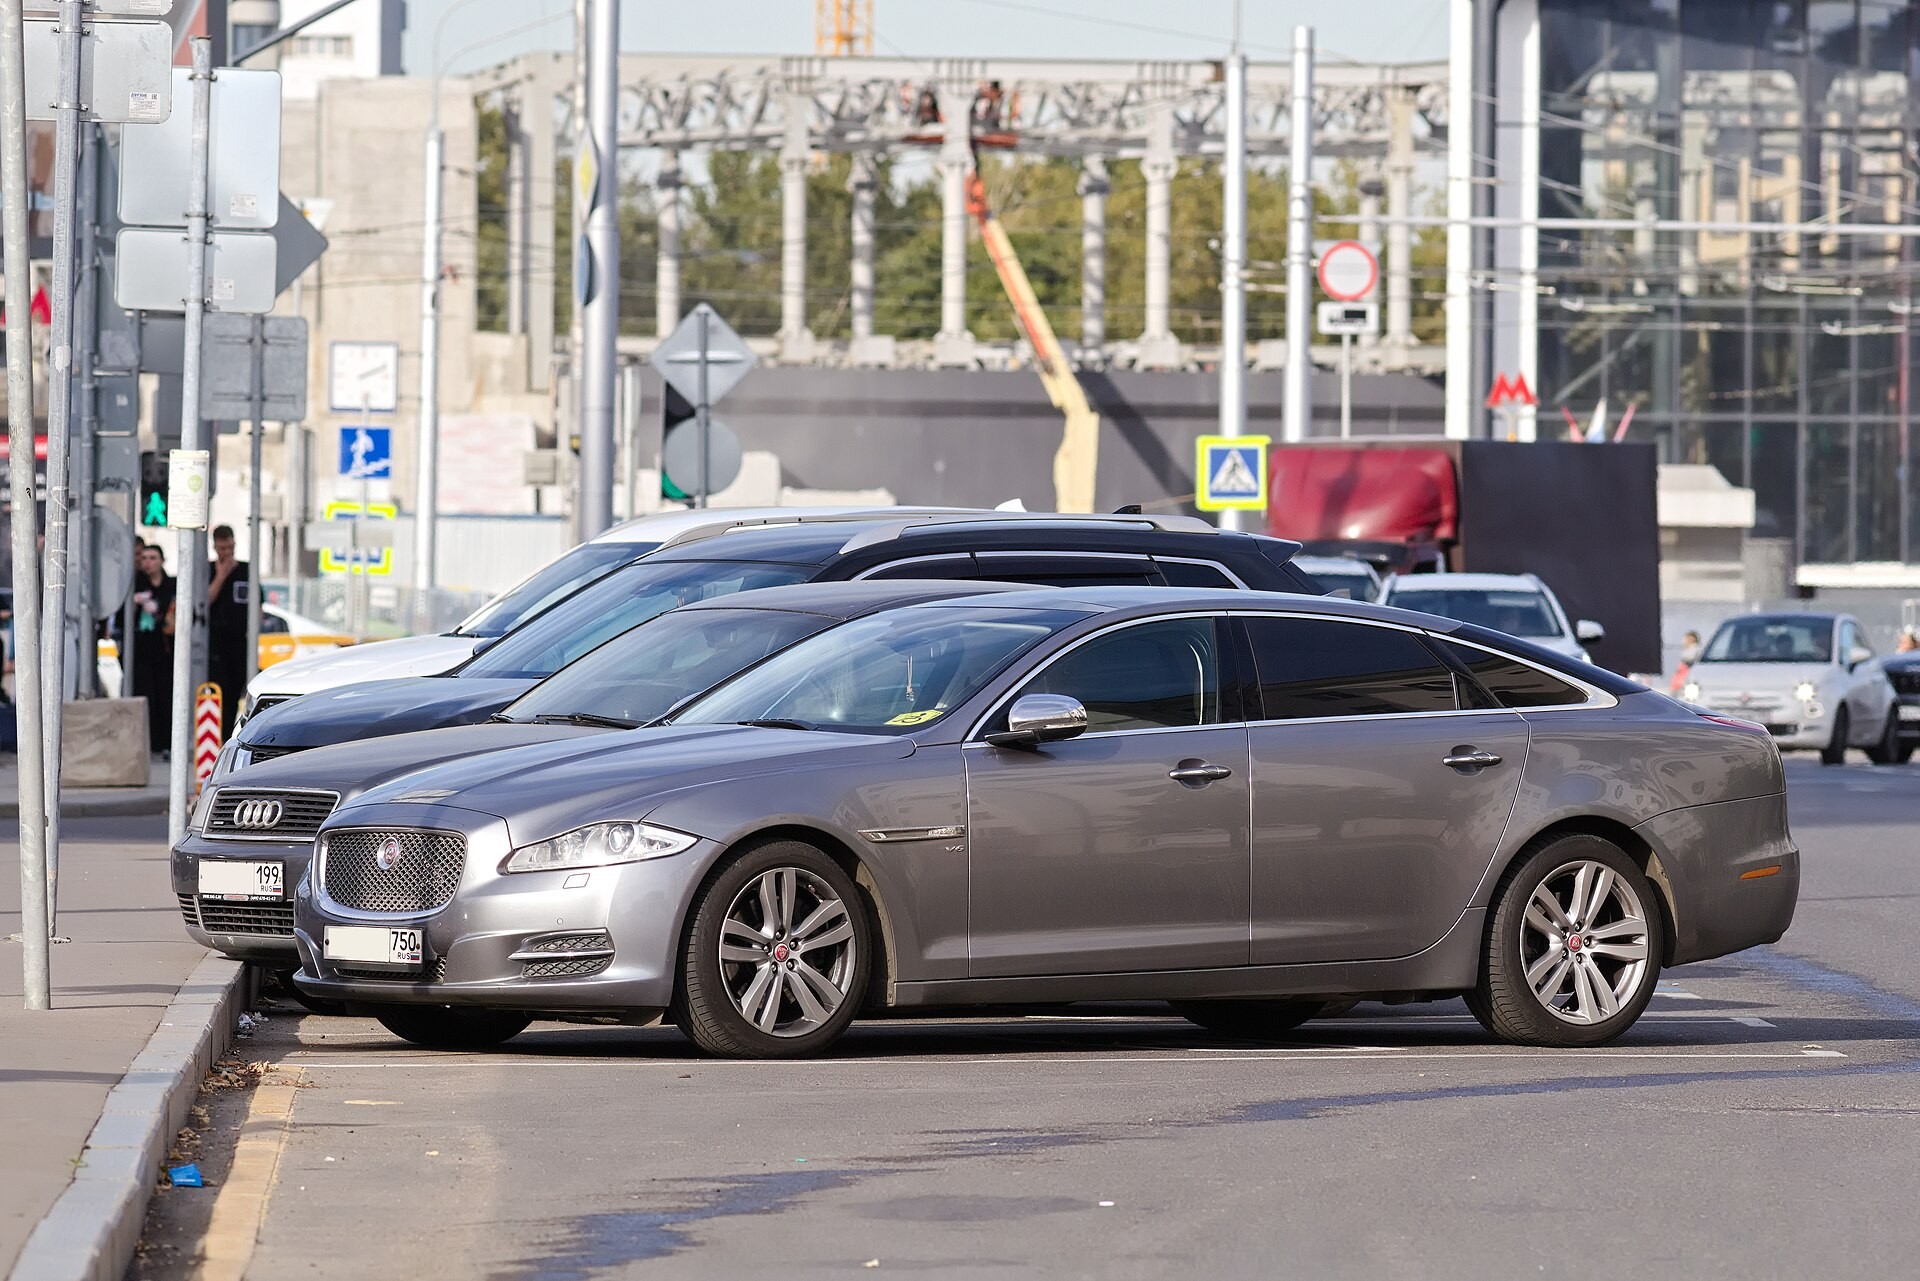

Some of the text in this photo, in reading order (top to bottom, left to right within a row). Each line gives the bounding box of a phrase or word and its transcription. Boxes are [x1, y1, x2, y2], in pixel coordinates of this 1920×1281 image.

[256, 865, 279, 884] 199
[260, 885, 273, 893] RUS
[391, 931, 417, 951] 750
[397, 951, 411, 960] RUS
